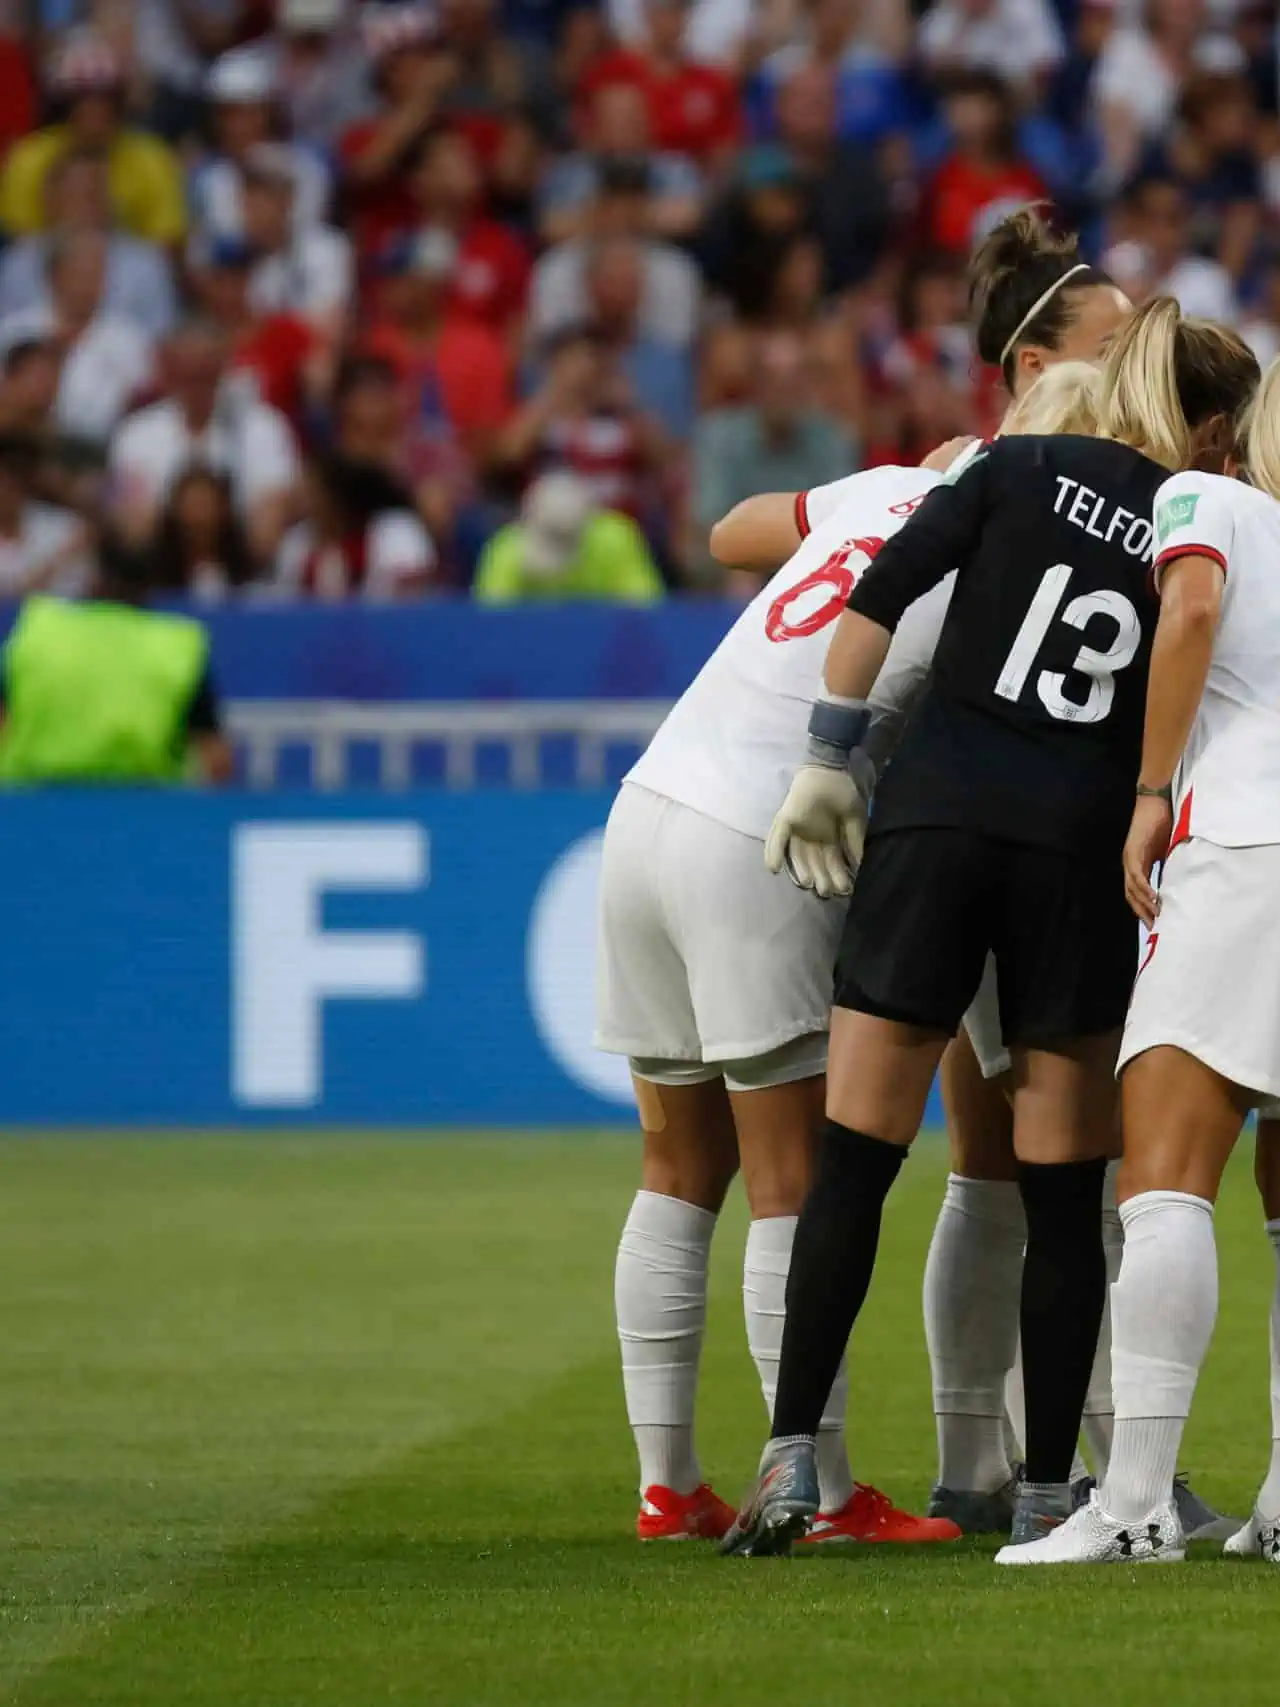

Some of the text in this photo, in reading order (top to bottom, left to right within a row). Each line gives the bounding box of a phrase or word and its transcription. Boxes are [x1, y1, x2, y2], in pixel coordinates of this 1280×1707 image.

[1054, 475, 1154, 564] TELFO
[765, 536, 886, 643] 6
[993, 562, 1142, 724] 13
